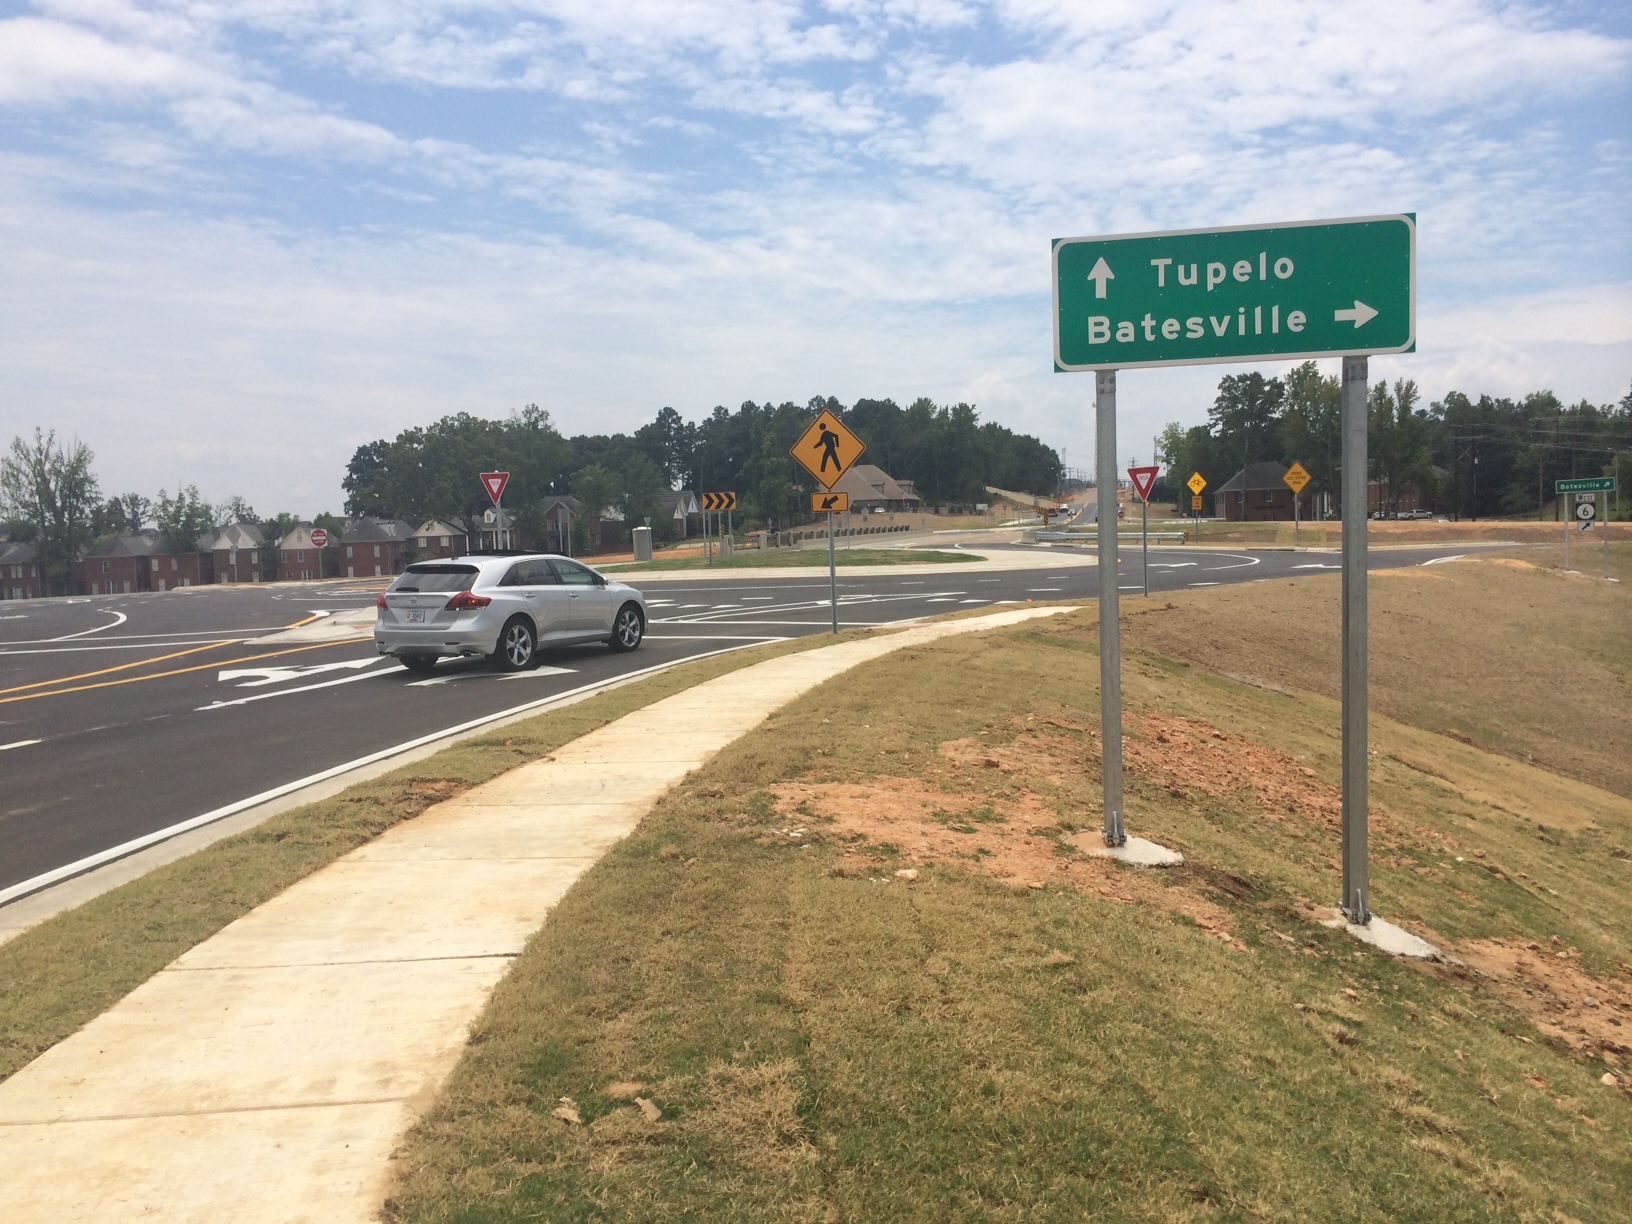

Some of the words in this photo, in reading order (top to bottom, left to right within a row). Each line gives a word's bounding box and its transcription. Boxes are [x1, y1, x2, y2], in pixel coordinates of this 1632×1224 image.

[1150, 251, 1295, 292] Tupelo
[1088, 304, 1307, 345] Batesville
[1582, 506, 1589, 516] 6
